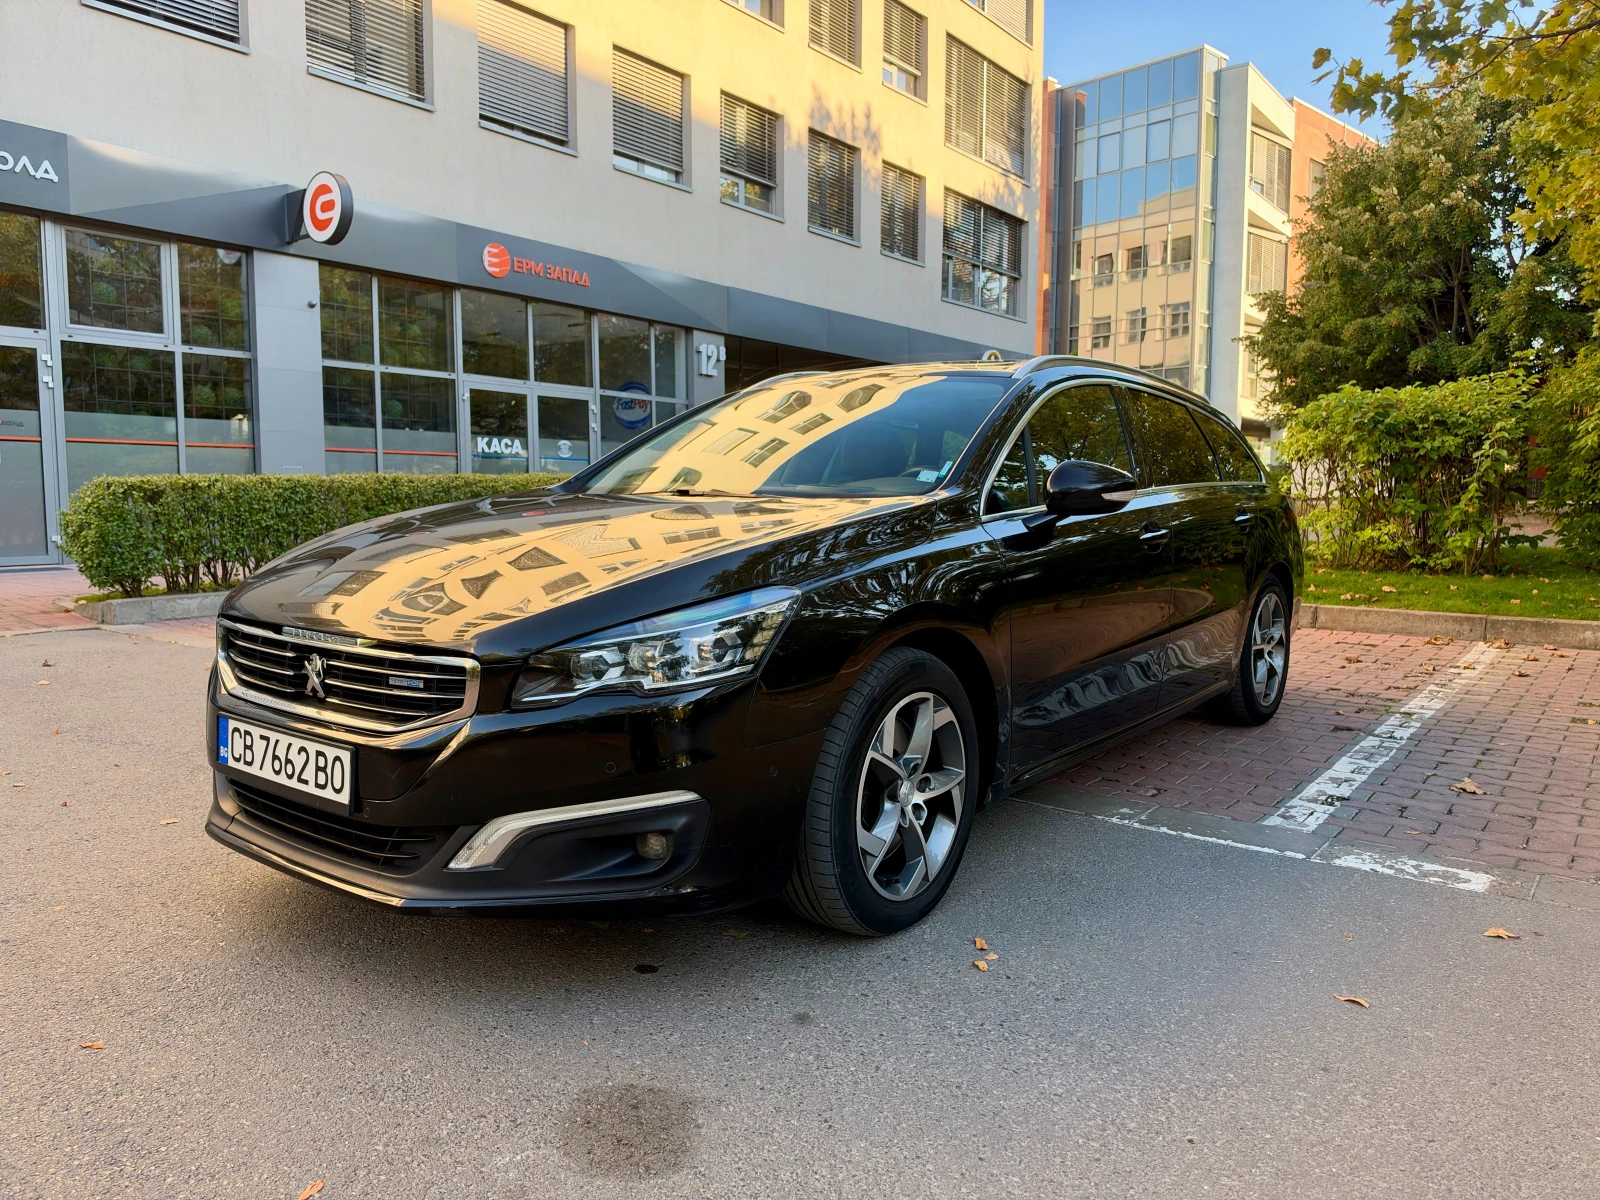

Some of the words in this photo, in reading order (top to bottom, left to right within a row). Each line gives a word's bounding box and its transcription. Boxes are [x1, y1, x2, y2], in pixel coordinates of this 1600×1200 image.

[513, 257, 544, 277] ЕРМ
[546, 264, 591, 287] ЗАПАД
[477, 437, 523, 455] КАСА
